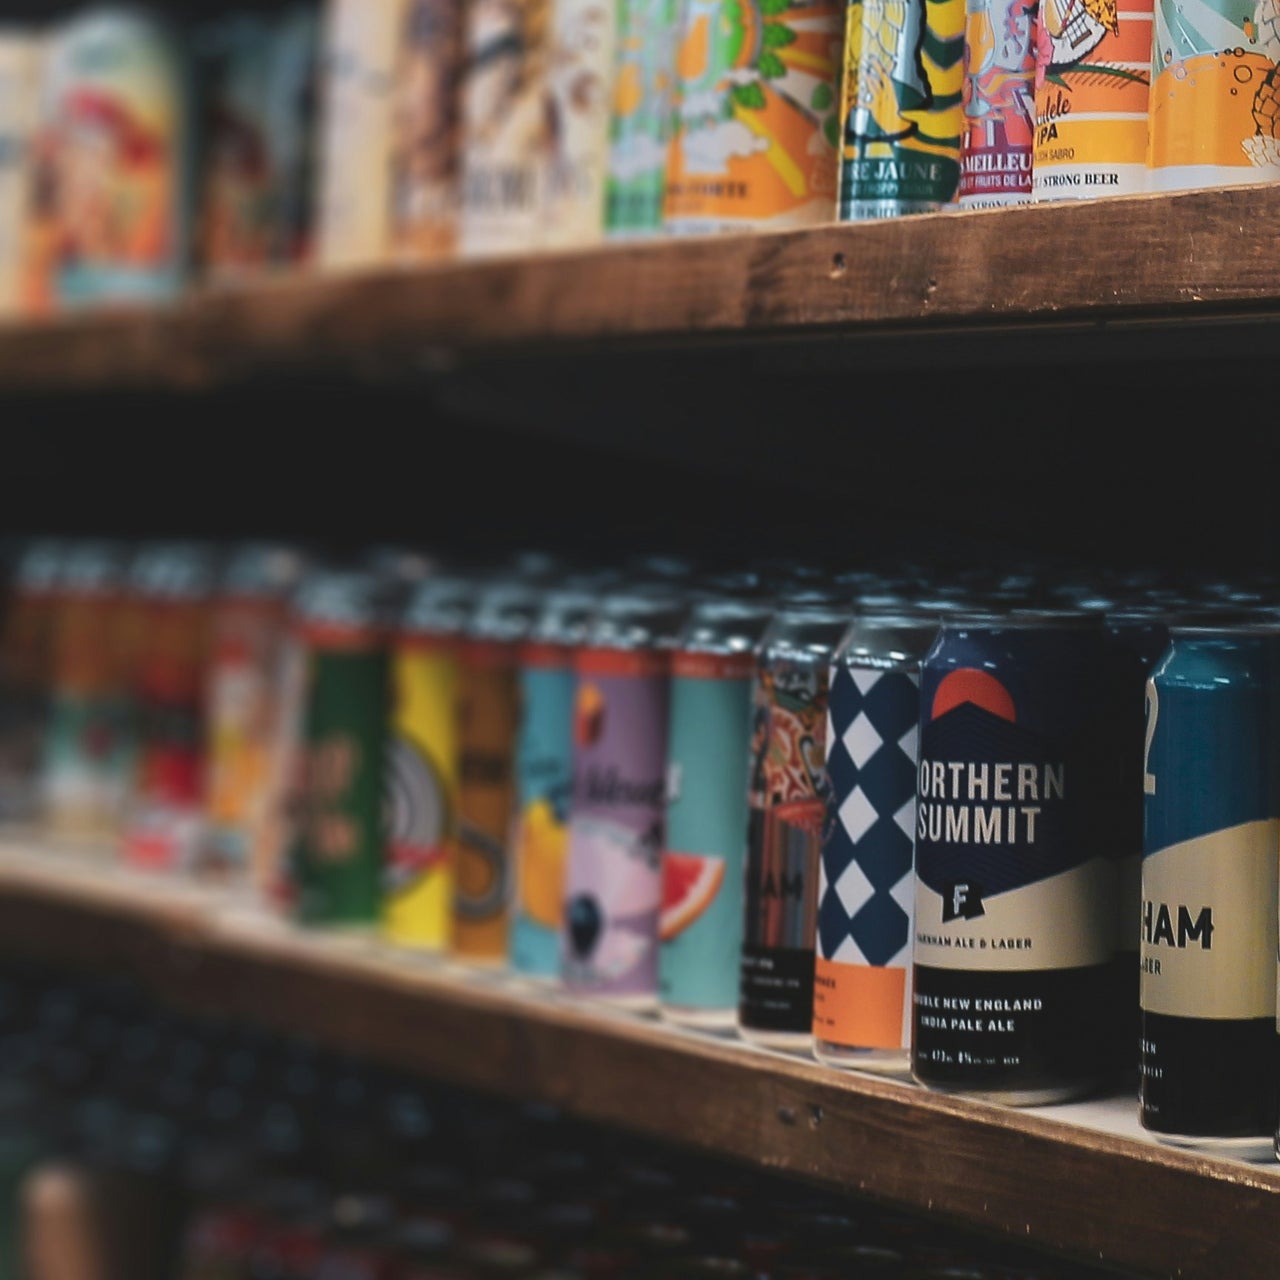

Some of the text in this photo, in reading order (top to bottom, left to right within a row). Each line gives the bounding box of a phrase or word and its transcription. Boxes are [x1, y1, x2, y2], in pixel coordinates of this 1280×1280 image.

[1036, 122, 1058, 148] IPA
[874, 160, 942, 181] JAUNE
[1003, 173, 1017, 188] DE
[1043, 172, 1119, 188] STRONG BEER
[919, 758, 1065, 801] ORTHERN
[917, 802, 1042, 845] SUMMIT
[955, 937, 975, 949] ALE
[992, 937, 1033, 950] LAGER
[943, 997, 1043, 1012] NEW ENGLAND
[951, 1018, 983, 1032] PALE
[988, 1019, 1015, 1032] ALE
